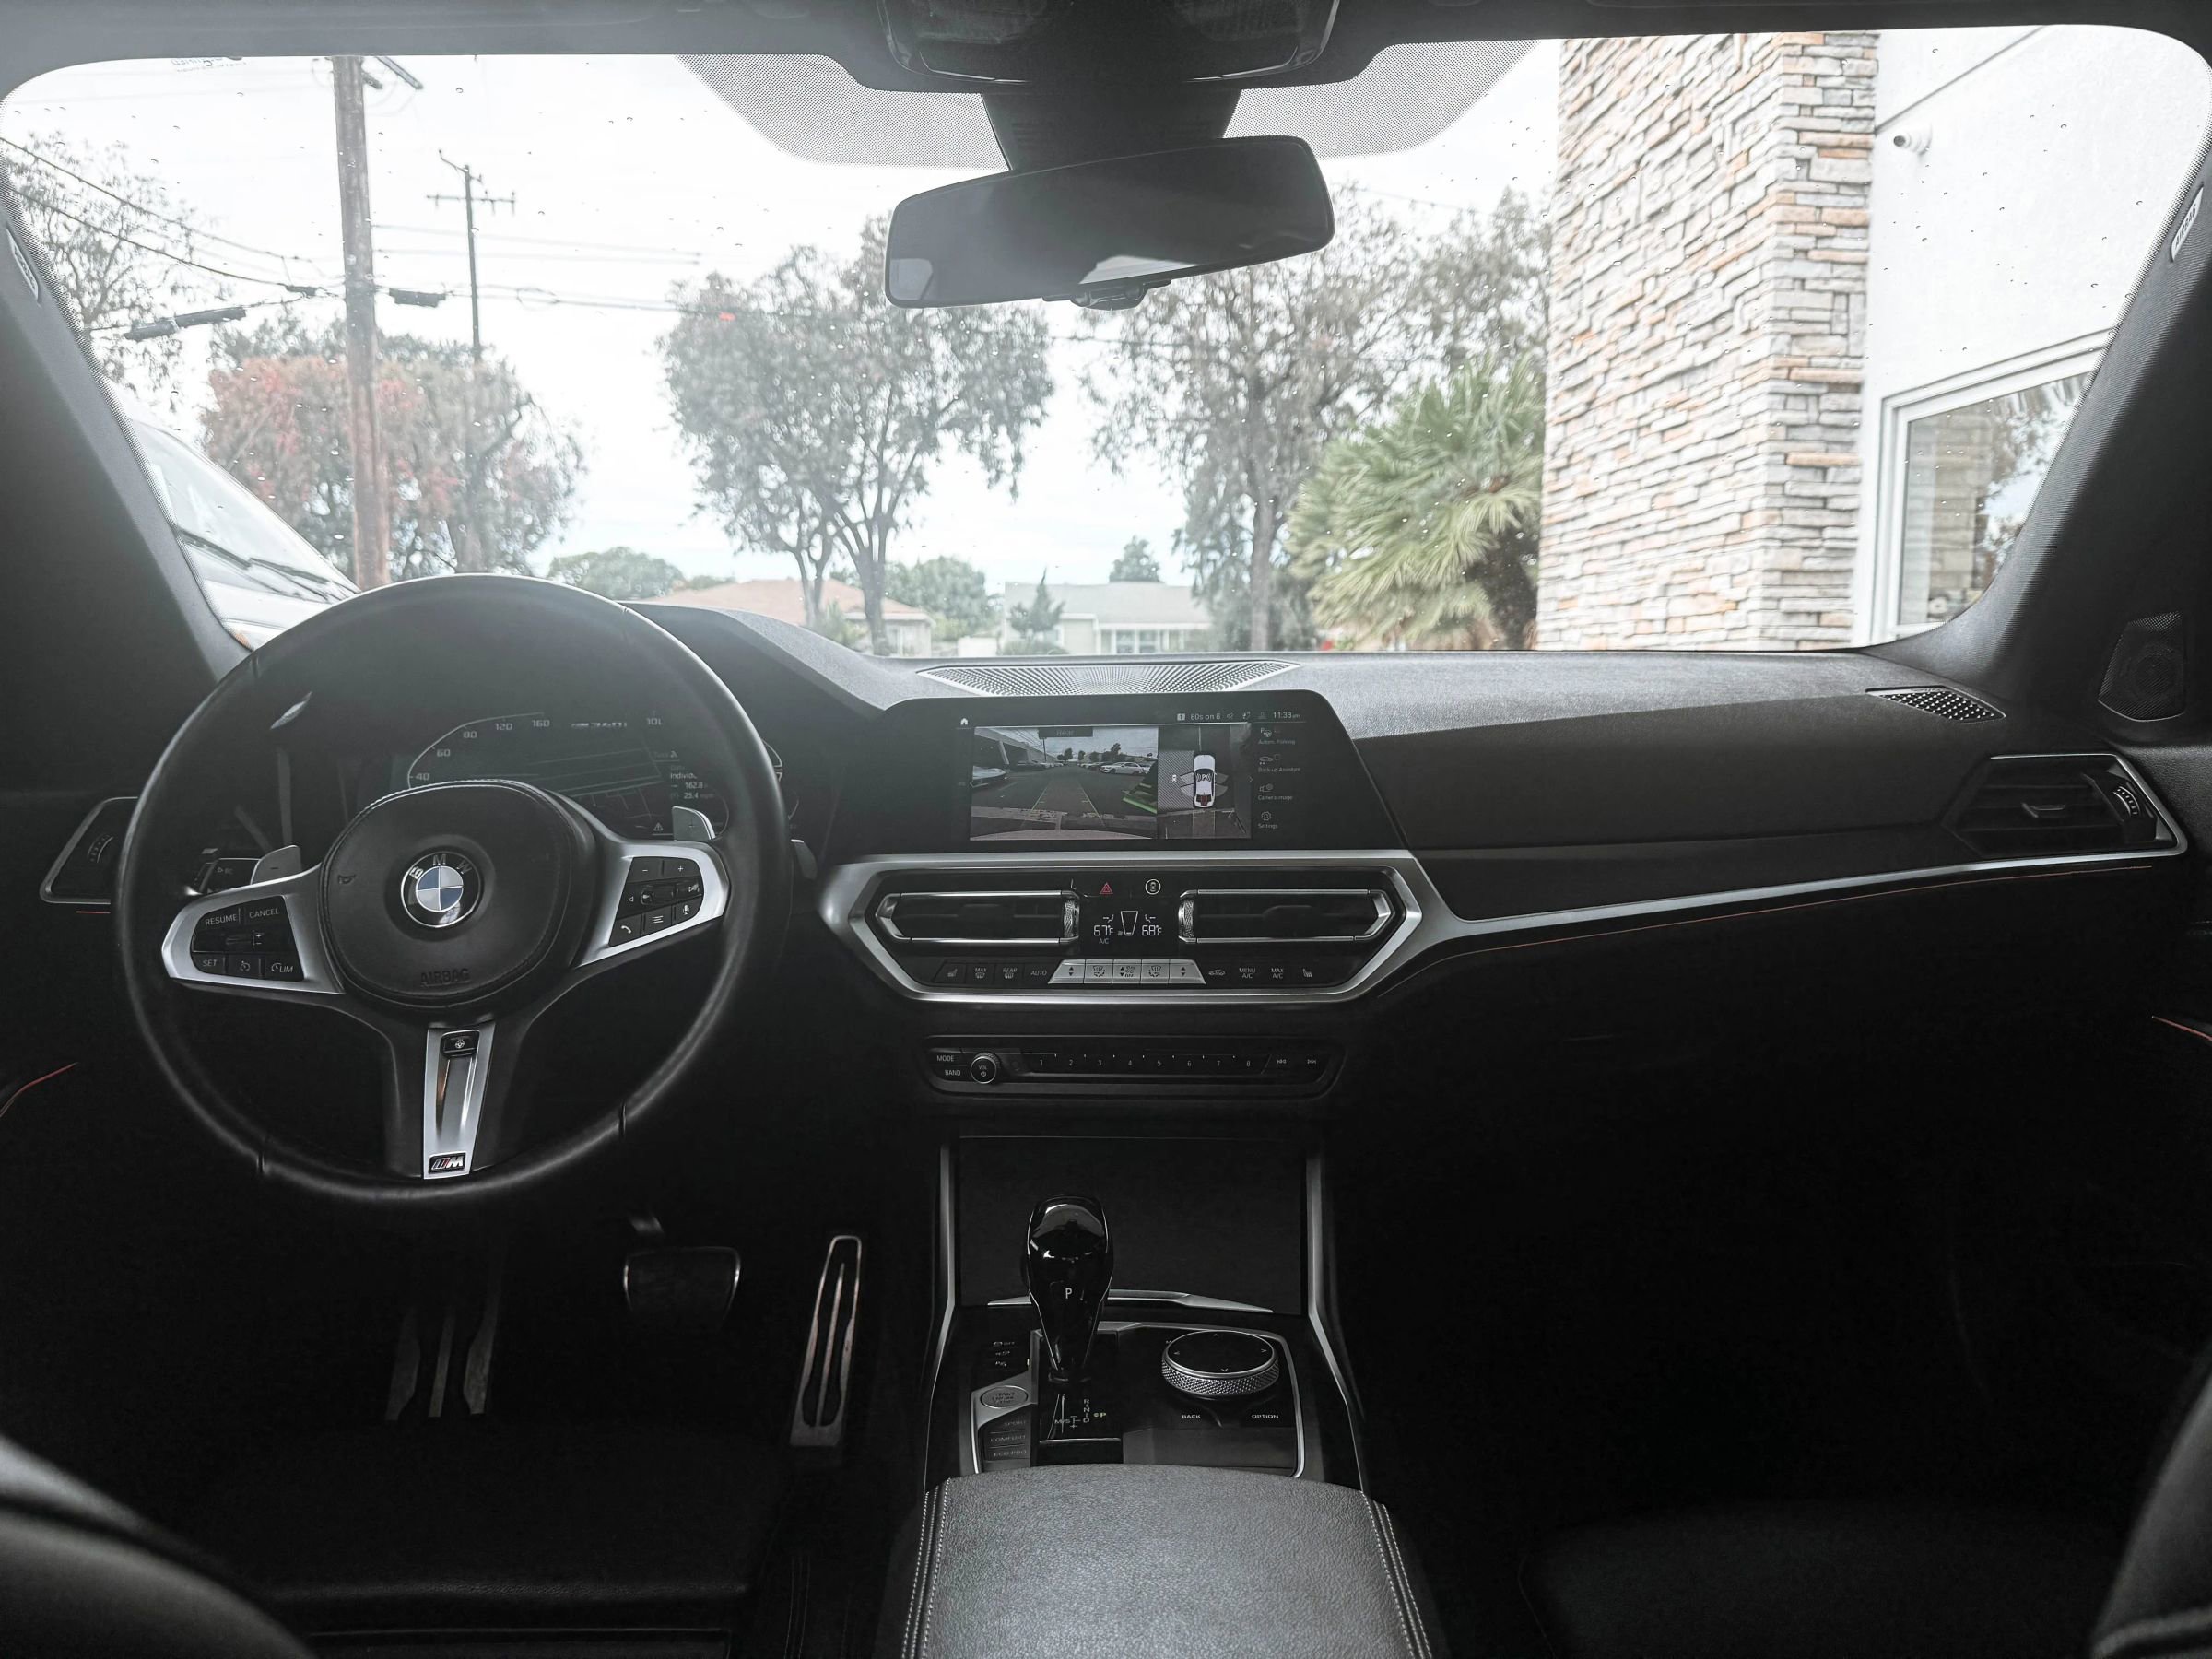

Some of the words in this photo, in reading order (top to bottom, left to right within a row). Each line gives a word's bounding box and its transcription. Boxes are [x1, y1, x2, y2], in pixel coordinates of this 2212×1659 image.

[495, 723, 513, 731] 120
[532, 719, 550, 727] 160
[436, 748, 451, 757] 60
[416, 772, 430, 781] 40
[409, 853, 472, 880] BMW
[249, 908, 279, 919] CANCEL
[205, 913, 237, 925] RESUME
[1065, 1288, 1073, 1300] P
